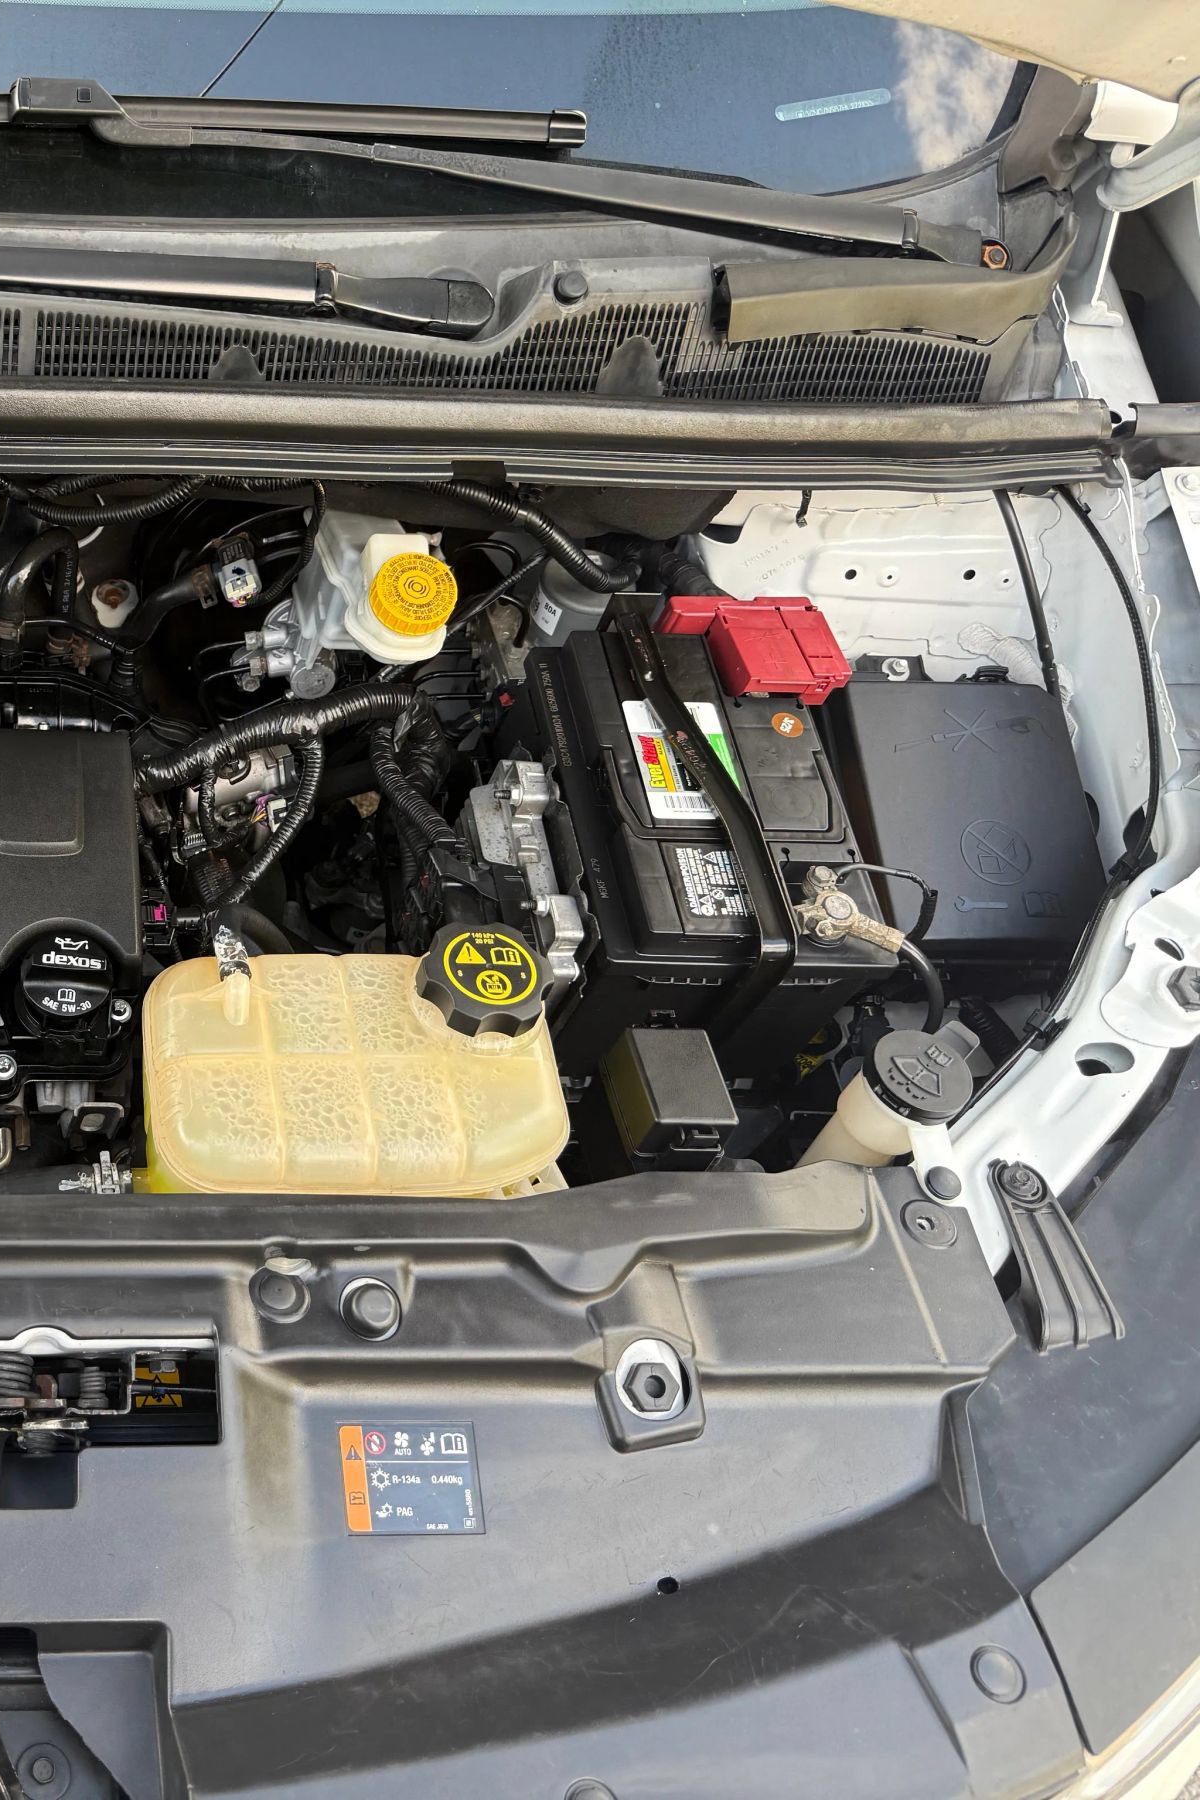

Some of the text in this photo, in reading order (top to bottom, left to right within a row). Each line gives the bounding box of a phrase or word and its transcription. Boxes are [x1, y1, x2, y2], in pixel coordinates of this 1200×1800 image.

[638, 735, 668, 788] EverStart
[42, 951, 102, 969] dexos
[42, 997, 92, 1013] SAE 5W-30
[394, 1448, 412, 1456] AUTO
[392, 1475, 463, 1486] R-134a 0.440kg
[396, 1507, 414, 1517] PAG
